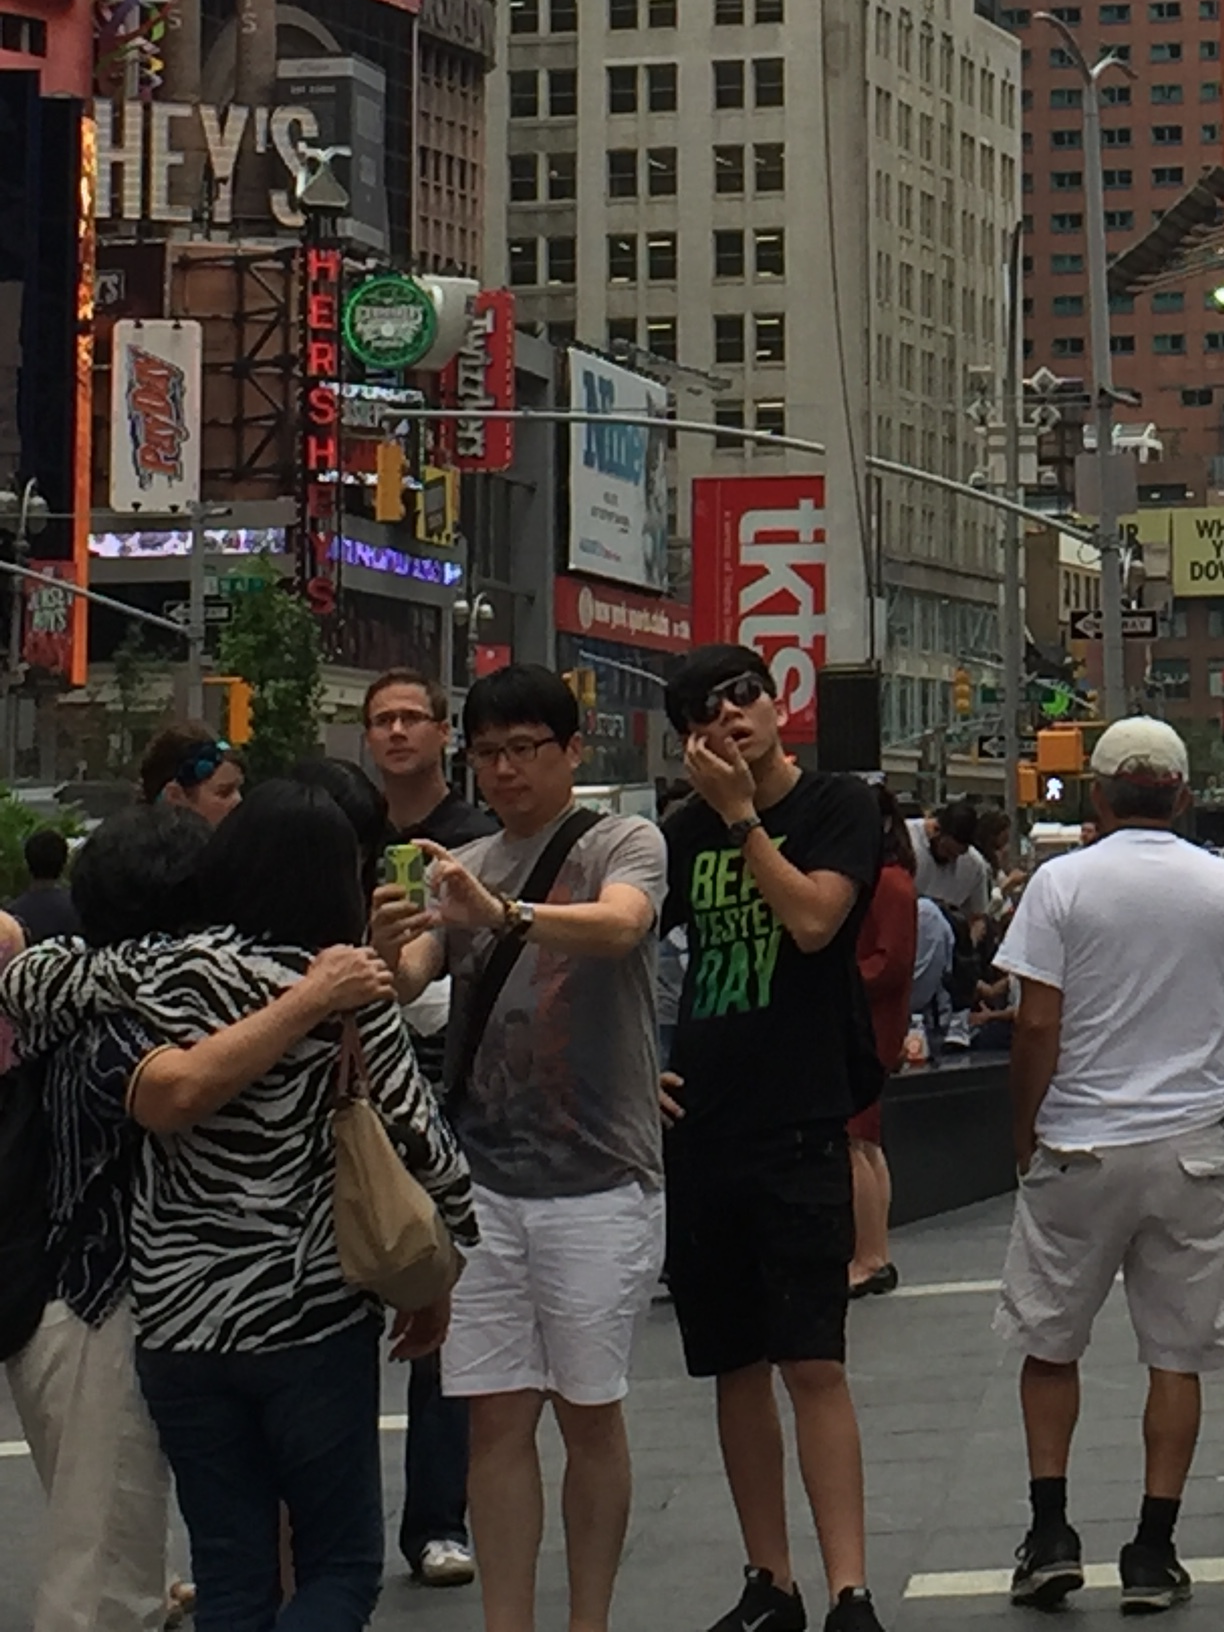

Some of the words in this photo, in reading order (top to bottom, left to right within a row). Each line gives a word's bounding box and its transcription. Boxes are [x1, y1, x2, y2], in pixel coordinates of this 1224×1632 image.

[306, 247, 341, 616] HERSHEYS
[738, 497, 826, 714] tkts
[1083, 618, 1102, 631] ON
[695, 898, 784, 949] YESTE
[691, 930, 784, 1019] DAY
